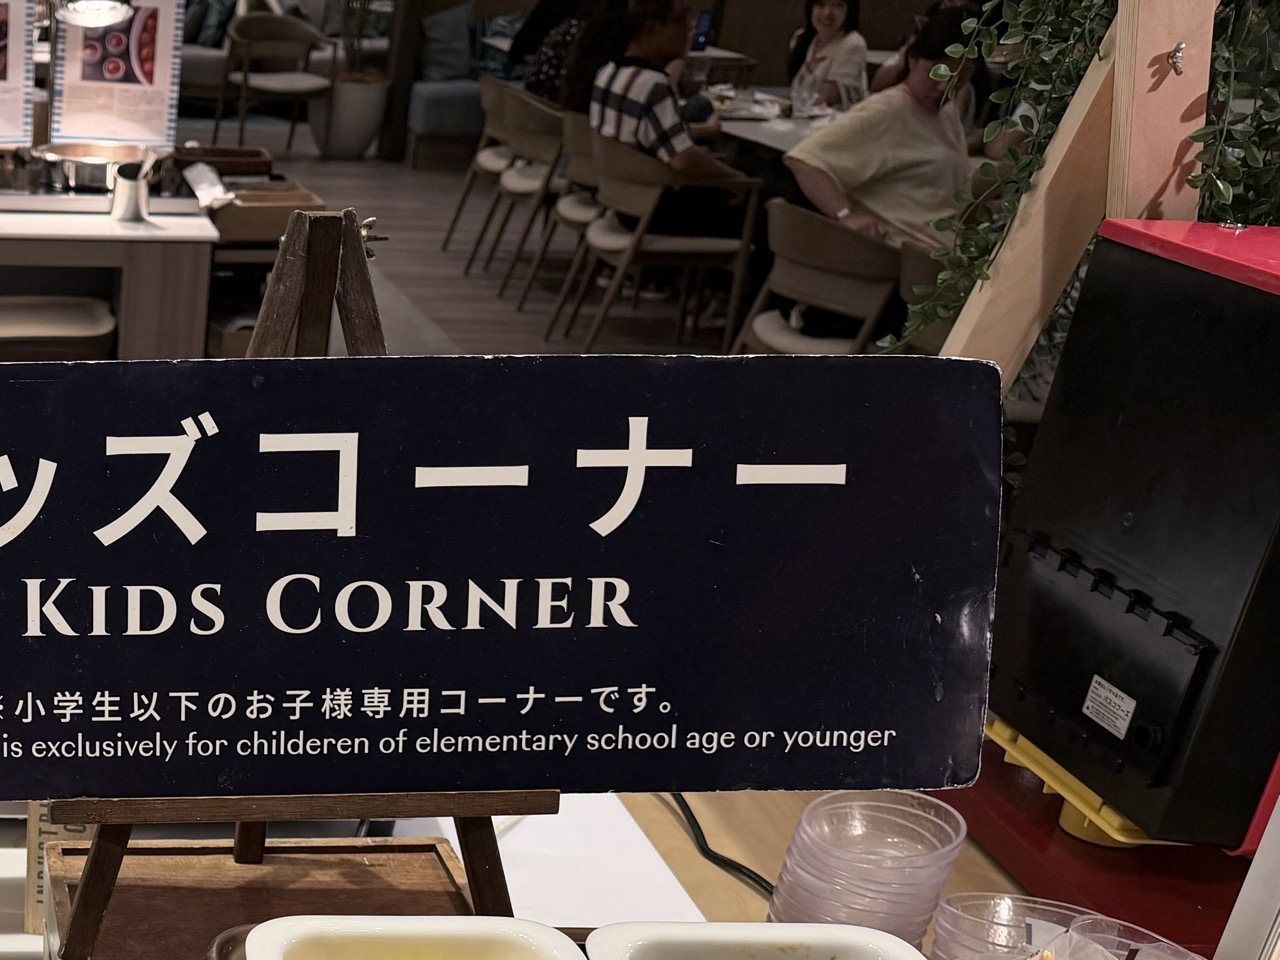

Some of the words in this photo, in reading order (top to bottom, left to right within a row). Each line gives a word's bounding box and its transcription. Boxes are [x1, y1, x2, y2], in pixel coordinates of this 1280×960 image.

[21, 579, 224, 636] KIDS
[266, 574, 638, 633] CORNER
[3, 734, 22, 757] is
[32, 732, 177, 761] exclusively
[186, 732, 227, 755] for
[237, 730, 368, 755] childeren
[380, 729, 407, 753] of
[416, 728, 578, 757] elementary
[587, 726, 677, 751] school
[687, 732, 735, 753] age
[744, 732, 774, 747] or
[784, 730, 896, 752] younger
